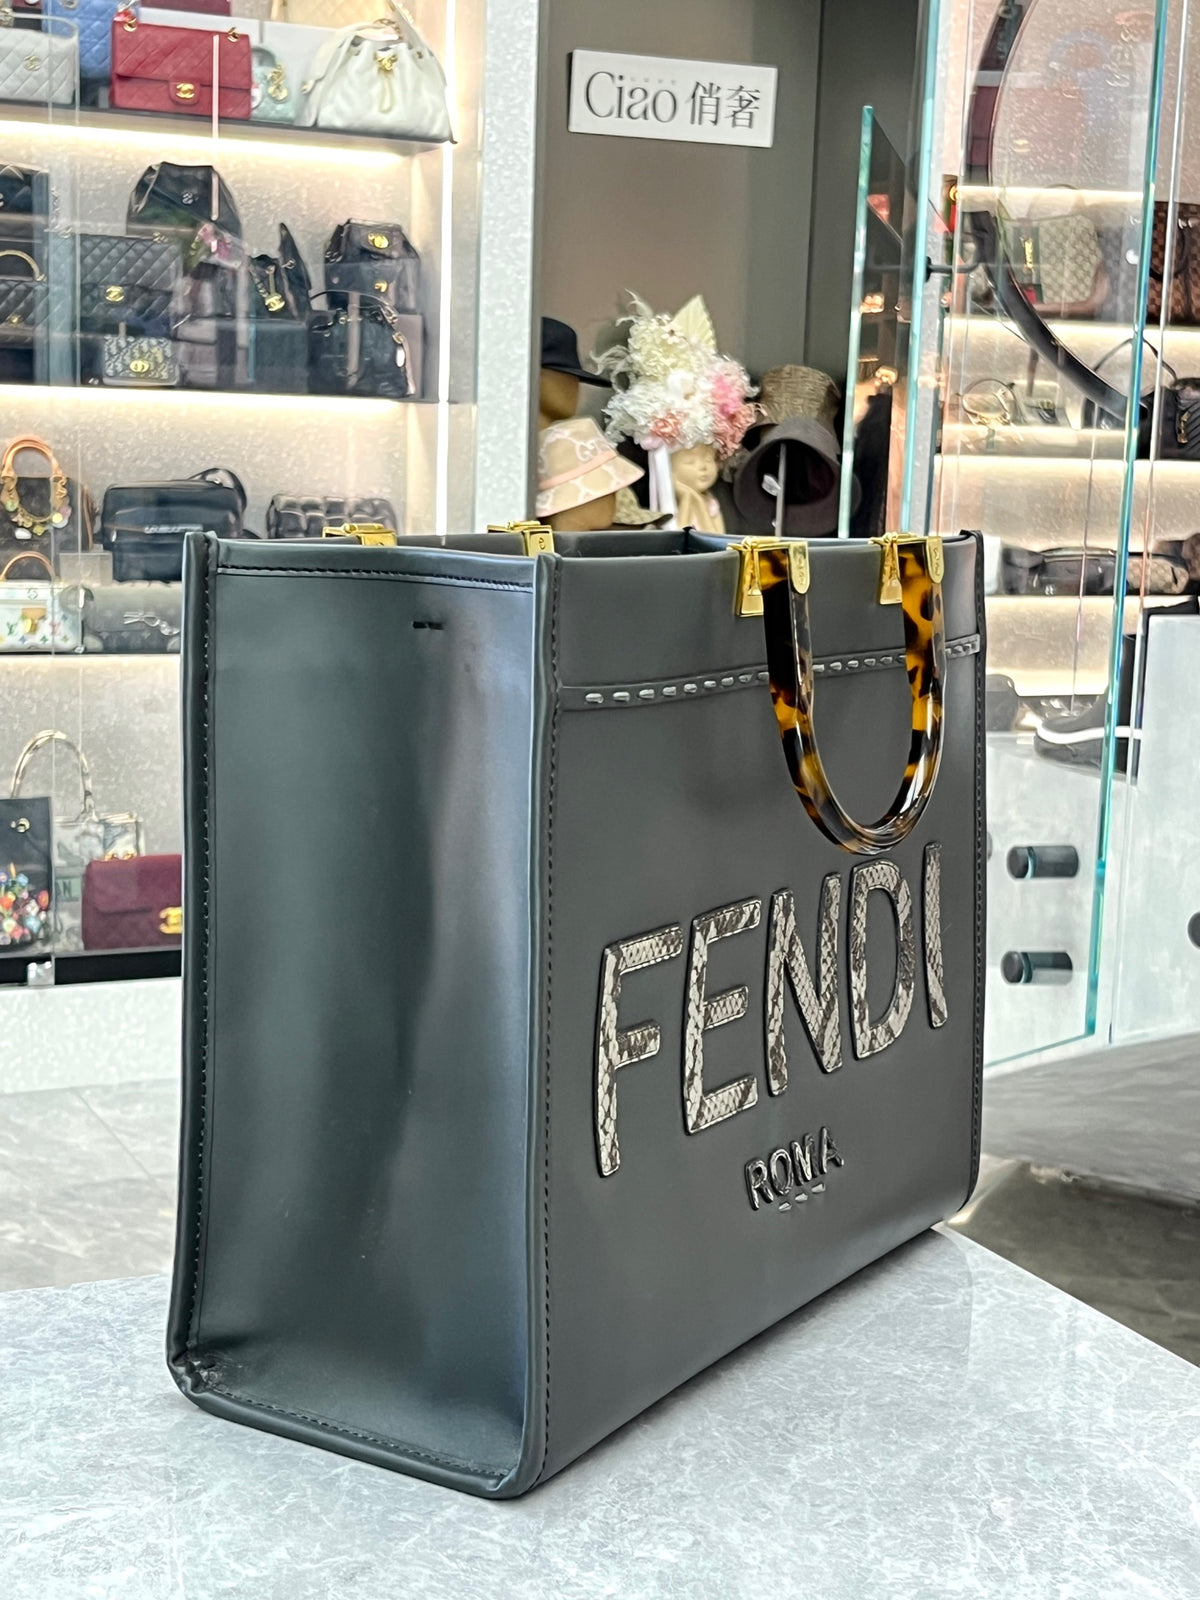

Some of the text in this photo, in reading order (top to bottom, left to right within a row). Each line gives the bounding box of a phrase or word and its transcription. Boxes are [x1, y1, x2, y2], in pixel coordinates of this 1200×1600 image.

[586, 71, 761, 129] Ciao 俏奢
[594, 841, 949, 1178] FENDI
[745, 1126, 844, 1211] ROMA
